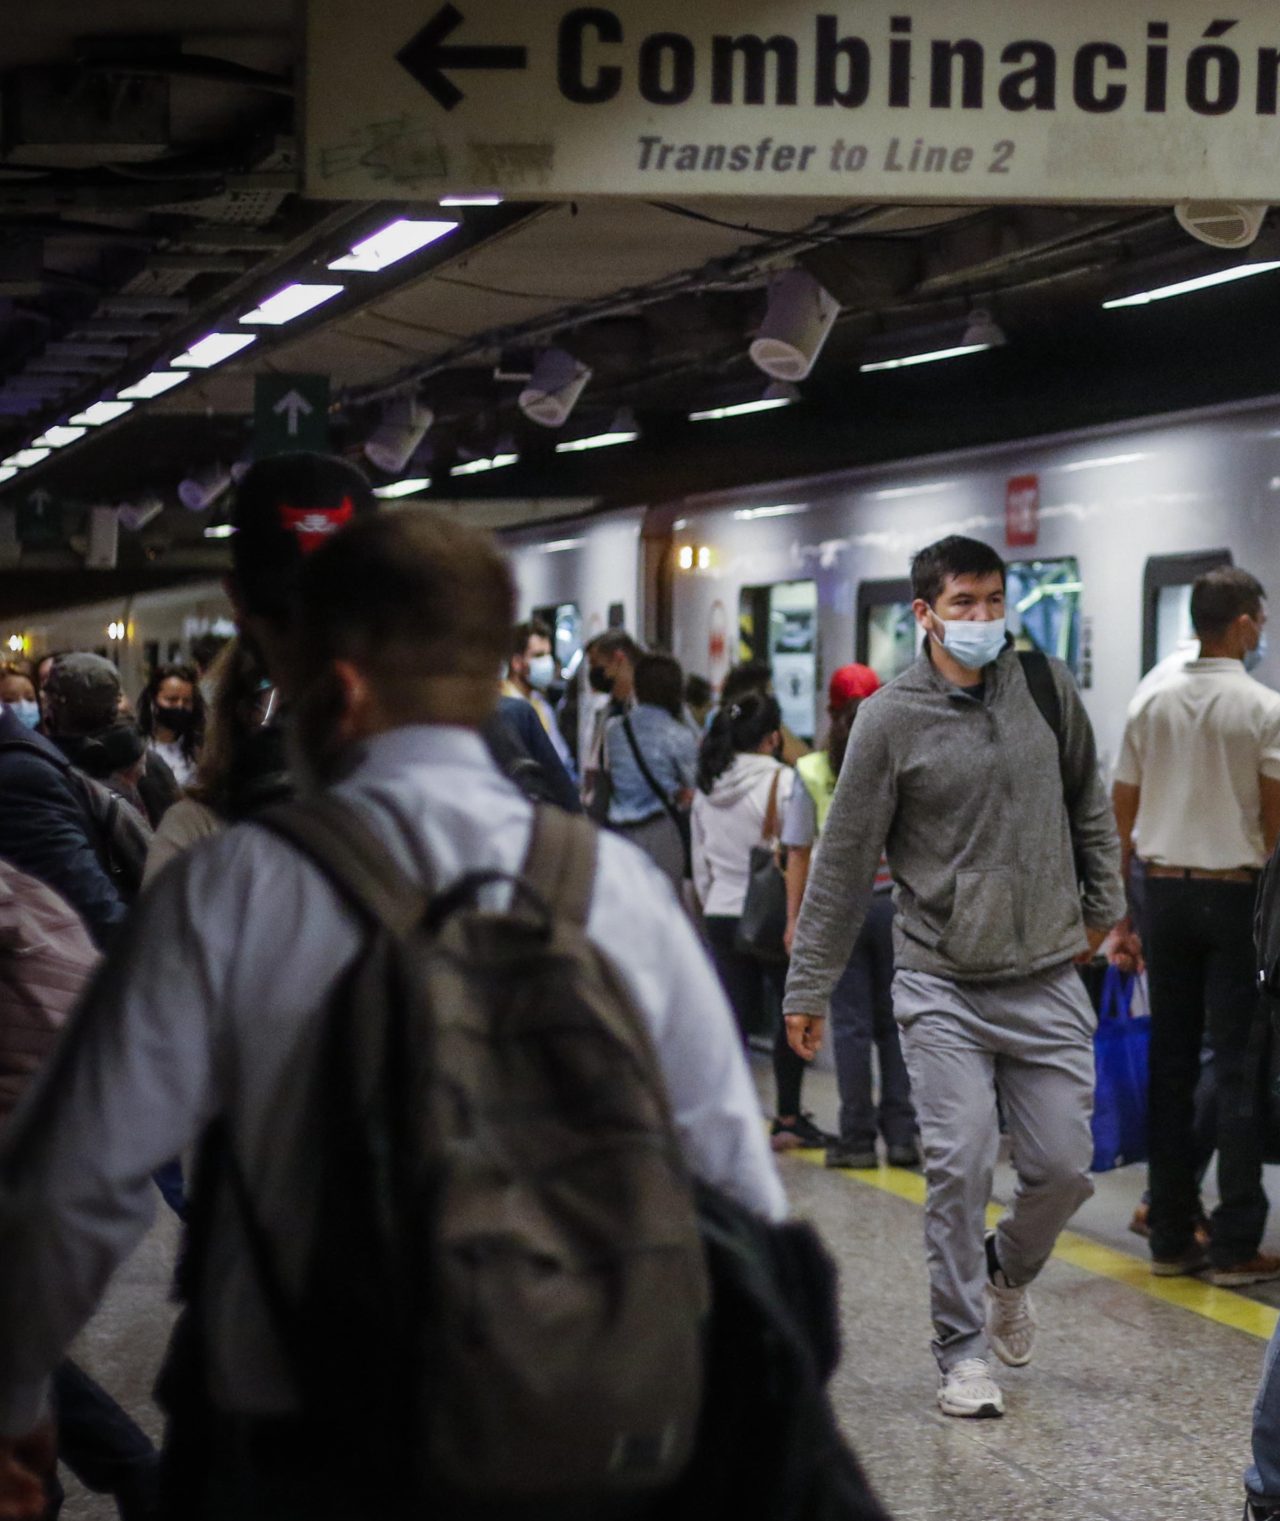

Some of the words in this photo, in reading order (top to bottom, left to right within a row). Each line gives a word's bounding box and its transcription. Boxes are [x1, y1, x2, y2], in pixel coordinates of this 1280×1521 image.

[638, 136, 816, 173] Transfer
[830, 141, 868, 172] to
[884, 138, 973, 173] Line
[988, 140, 1015, 173] 2
